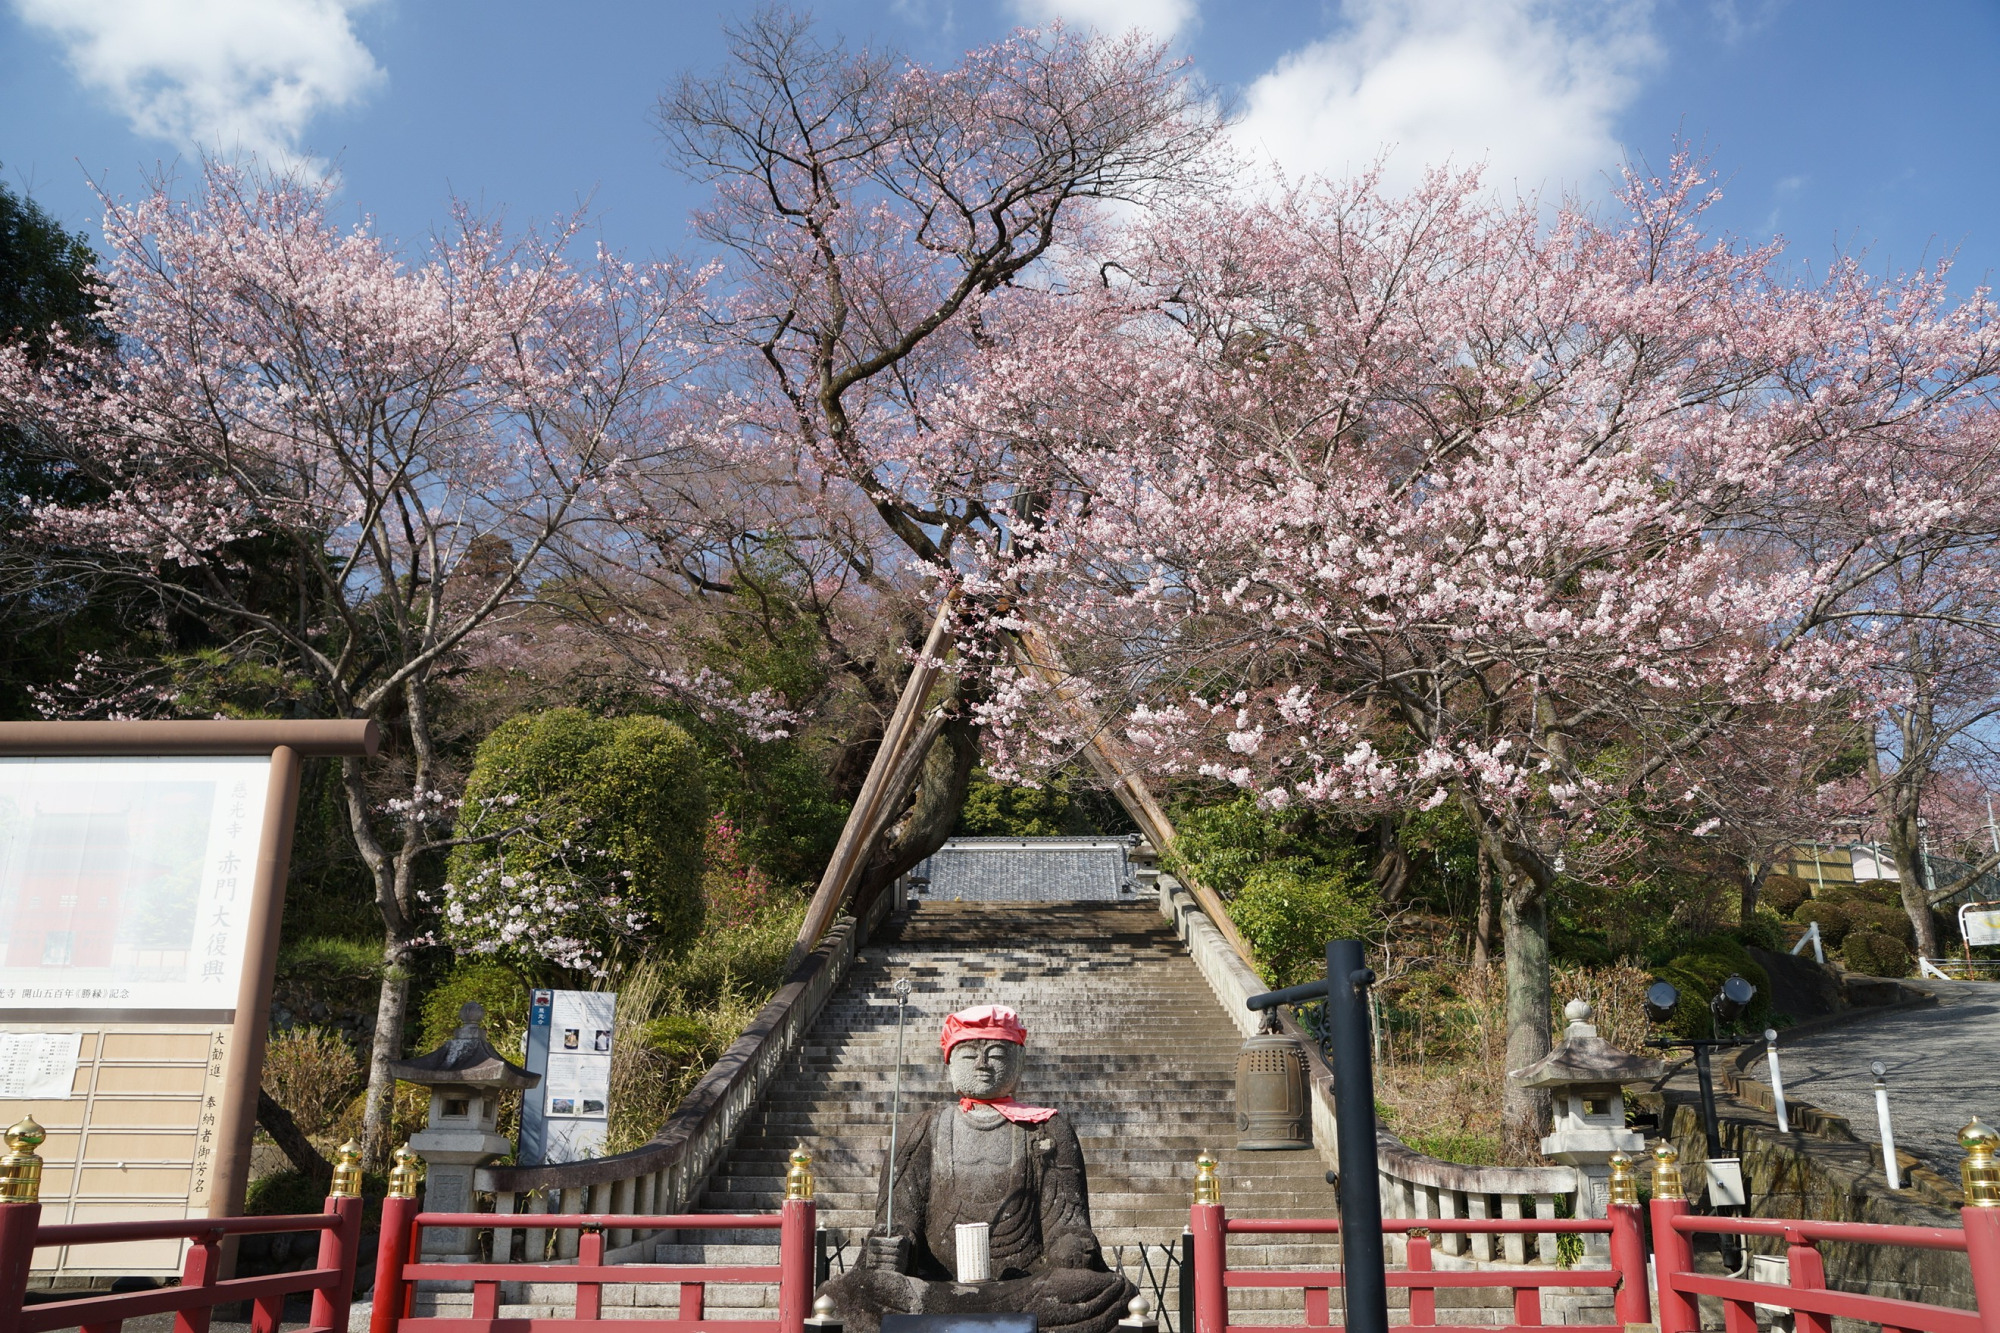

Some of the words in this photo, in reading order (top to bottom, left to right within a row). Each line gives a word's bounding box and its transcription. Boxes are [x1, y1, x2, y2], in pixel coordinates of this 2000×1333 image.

[201, 850, 242, 984] 赤門大復興
